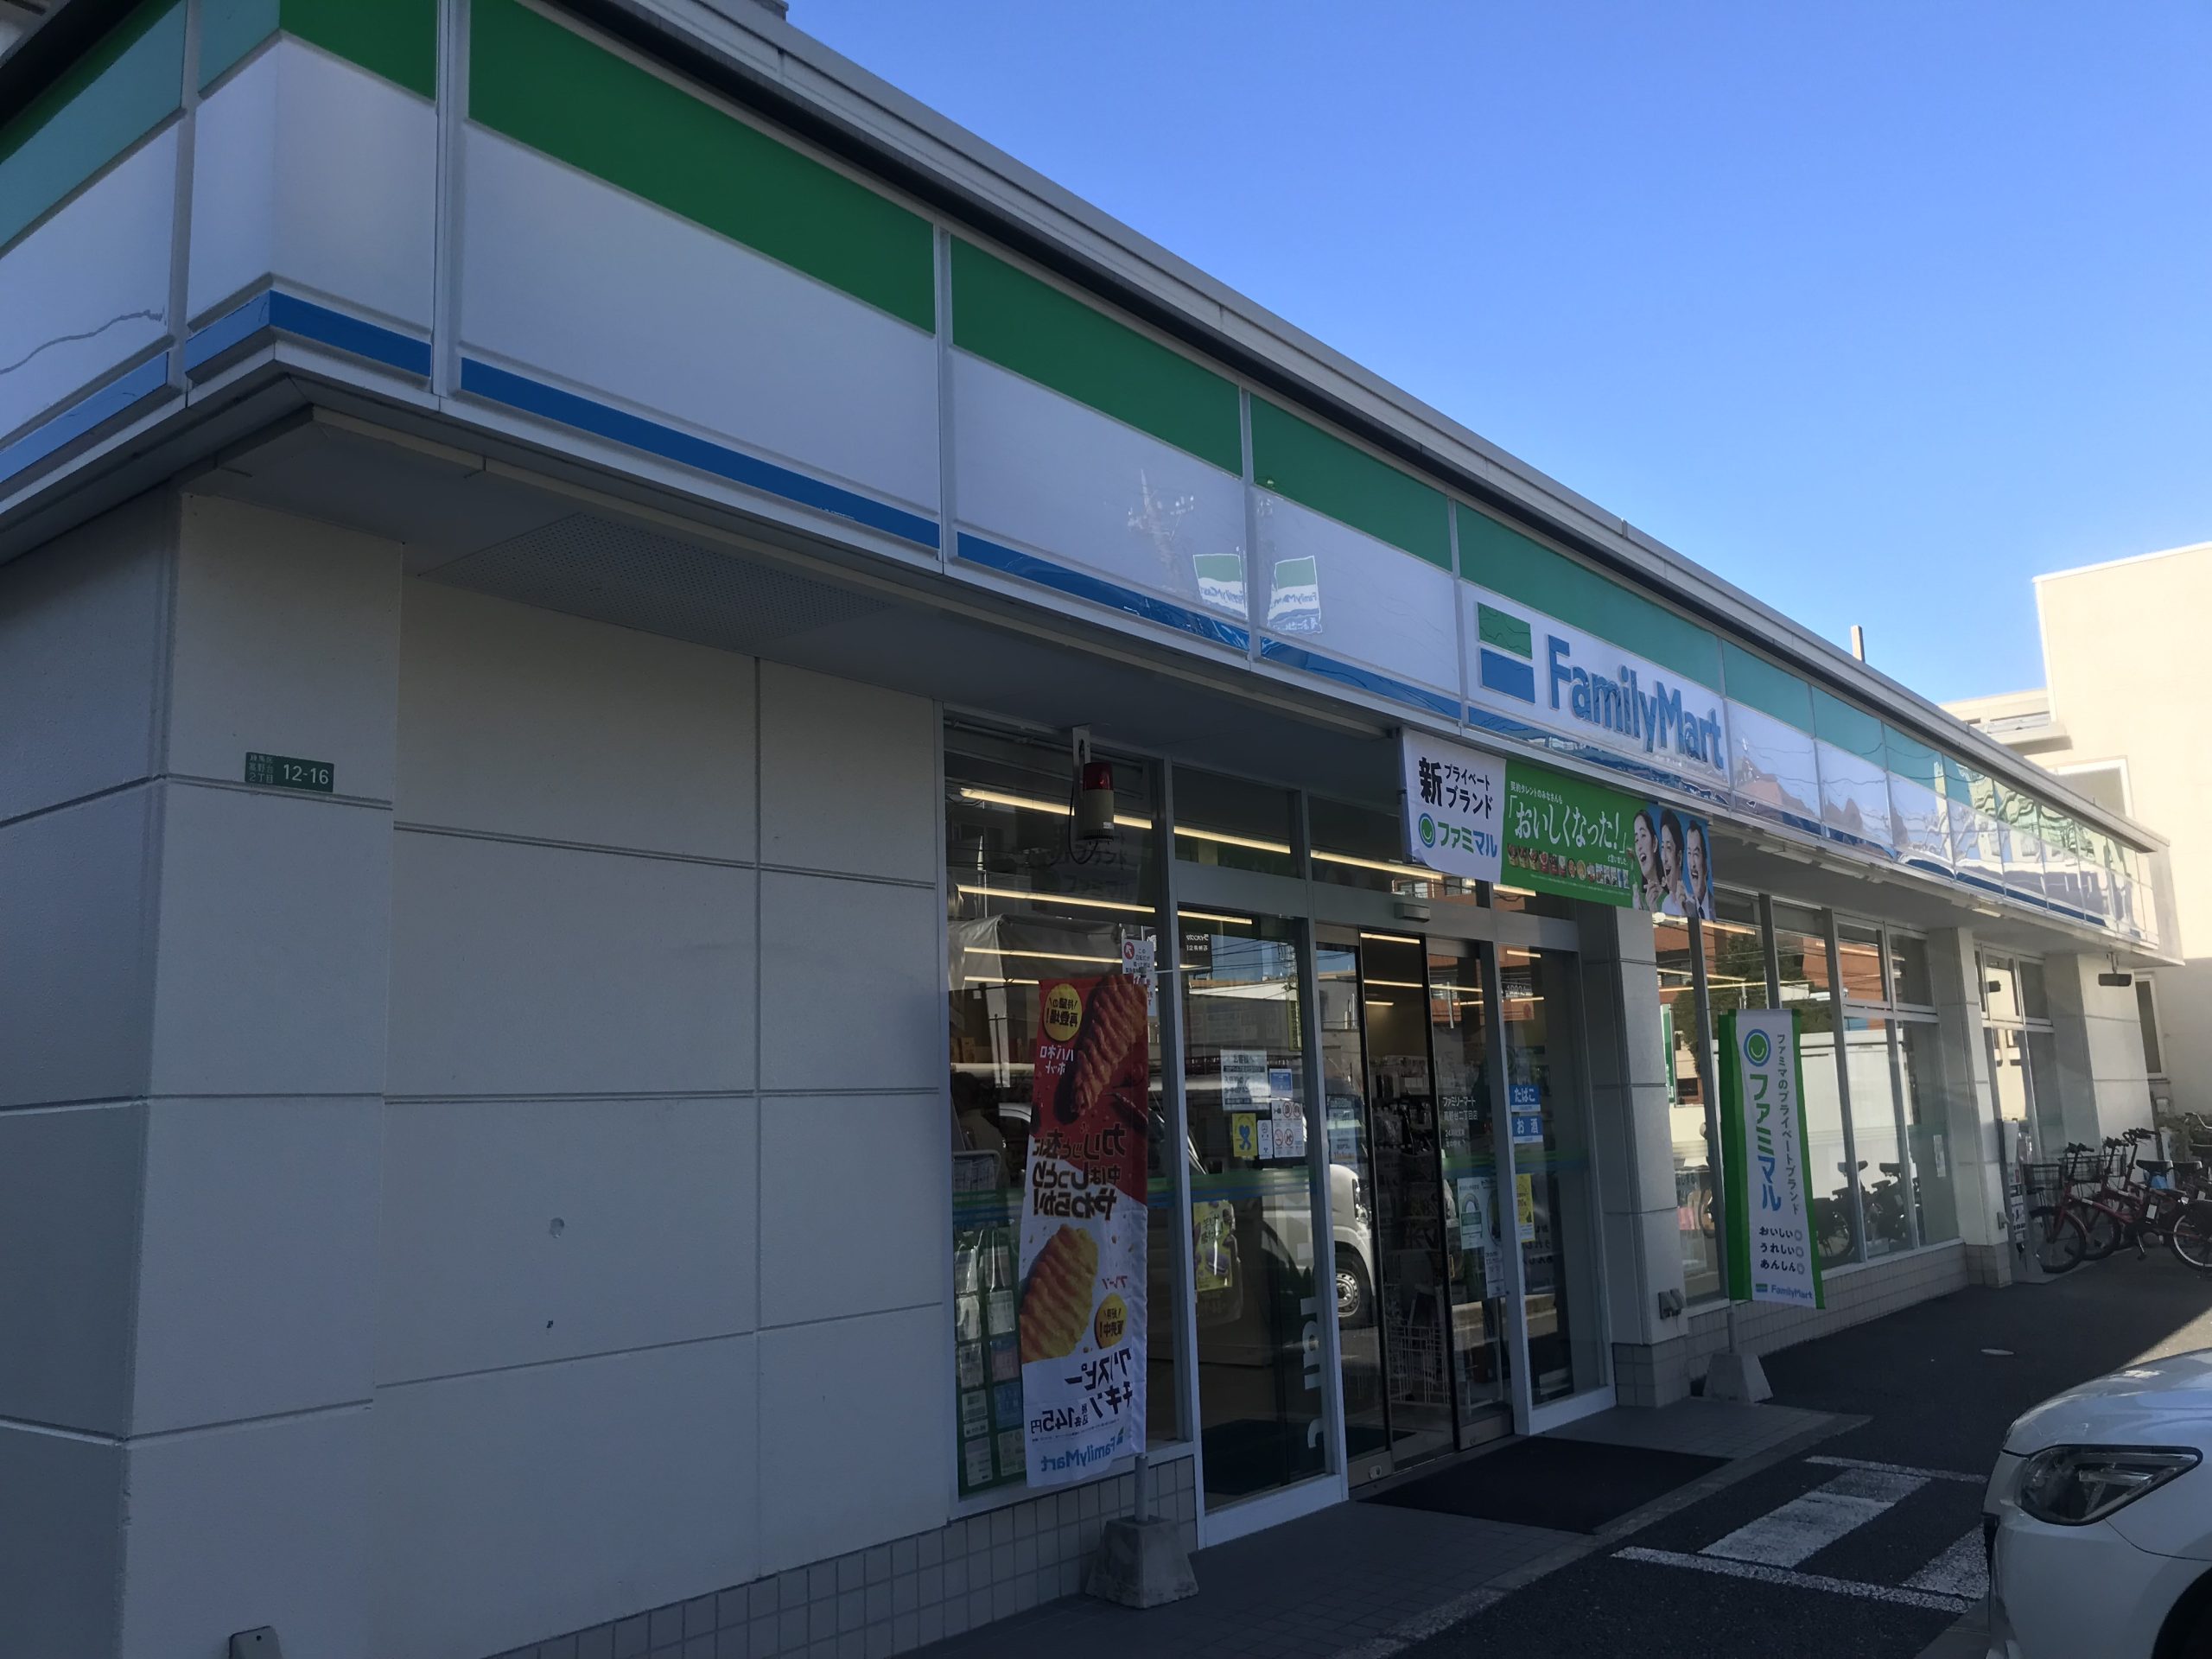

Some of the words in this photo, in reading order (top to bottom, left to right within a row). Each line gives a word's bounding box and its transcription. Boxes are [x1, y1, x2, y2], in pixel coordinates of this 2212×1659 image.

[1547, 634, 1724, 770] FamilyMart
[283, 764, 329, 785] 12-16
[1419, 757, 1443, 808] 新
[1444, 764, 1491, 791] プライベート
[1446, 786, 1493, 819] ブランド
[1438, 821, 1497, 858] ファミマル
[1442, 1096, 1476, 1107] ファミリーマート
[1514, 1086, 1536, 1103] たばこ
[1516, 1118, 1539, 1135] お酒
[1777, 1033, 1800, 1215] ファミマのプライベートブランド
[1750, 1073, 1782, 1211] ファミマル
[1771, 1284, 1814, 1300] FamilyMart
